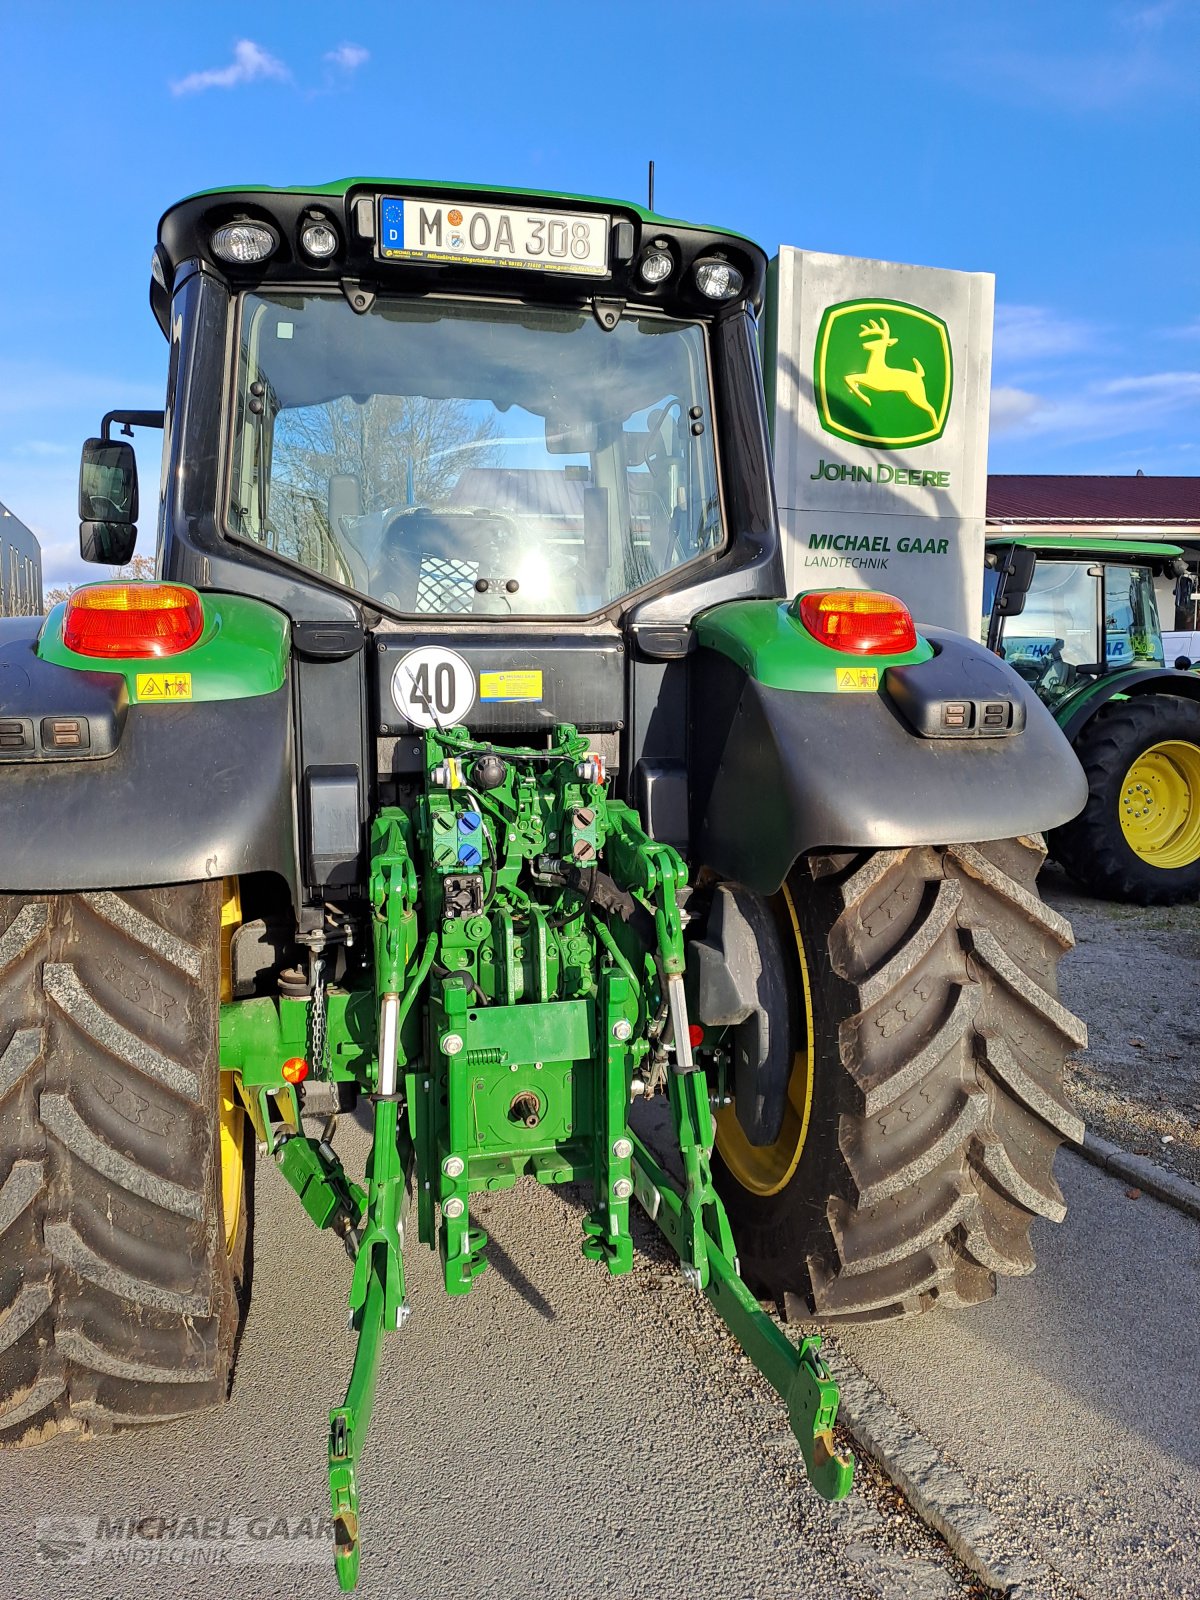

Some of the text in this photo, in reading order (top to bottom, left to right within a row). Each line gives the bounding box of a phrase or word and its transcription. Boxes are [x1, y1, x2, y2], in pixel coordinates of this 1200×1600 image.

[389, 229, 398, 241] D
[420, 208, 591, 260] M OA 308
[810, 460, 950, 488] JOHN DEERE
[808, 533, 949, 555] MICHAEL GAAR
[804, 555, 889, 570] LANDTECHNIK
[409, 662, 456, 714] 40
